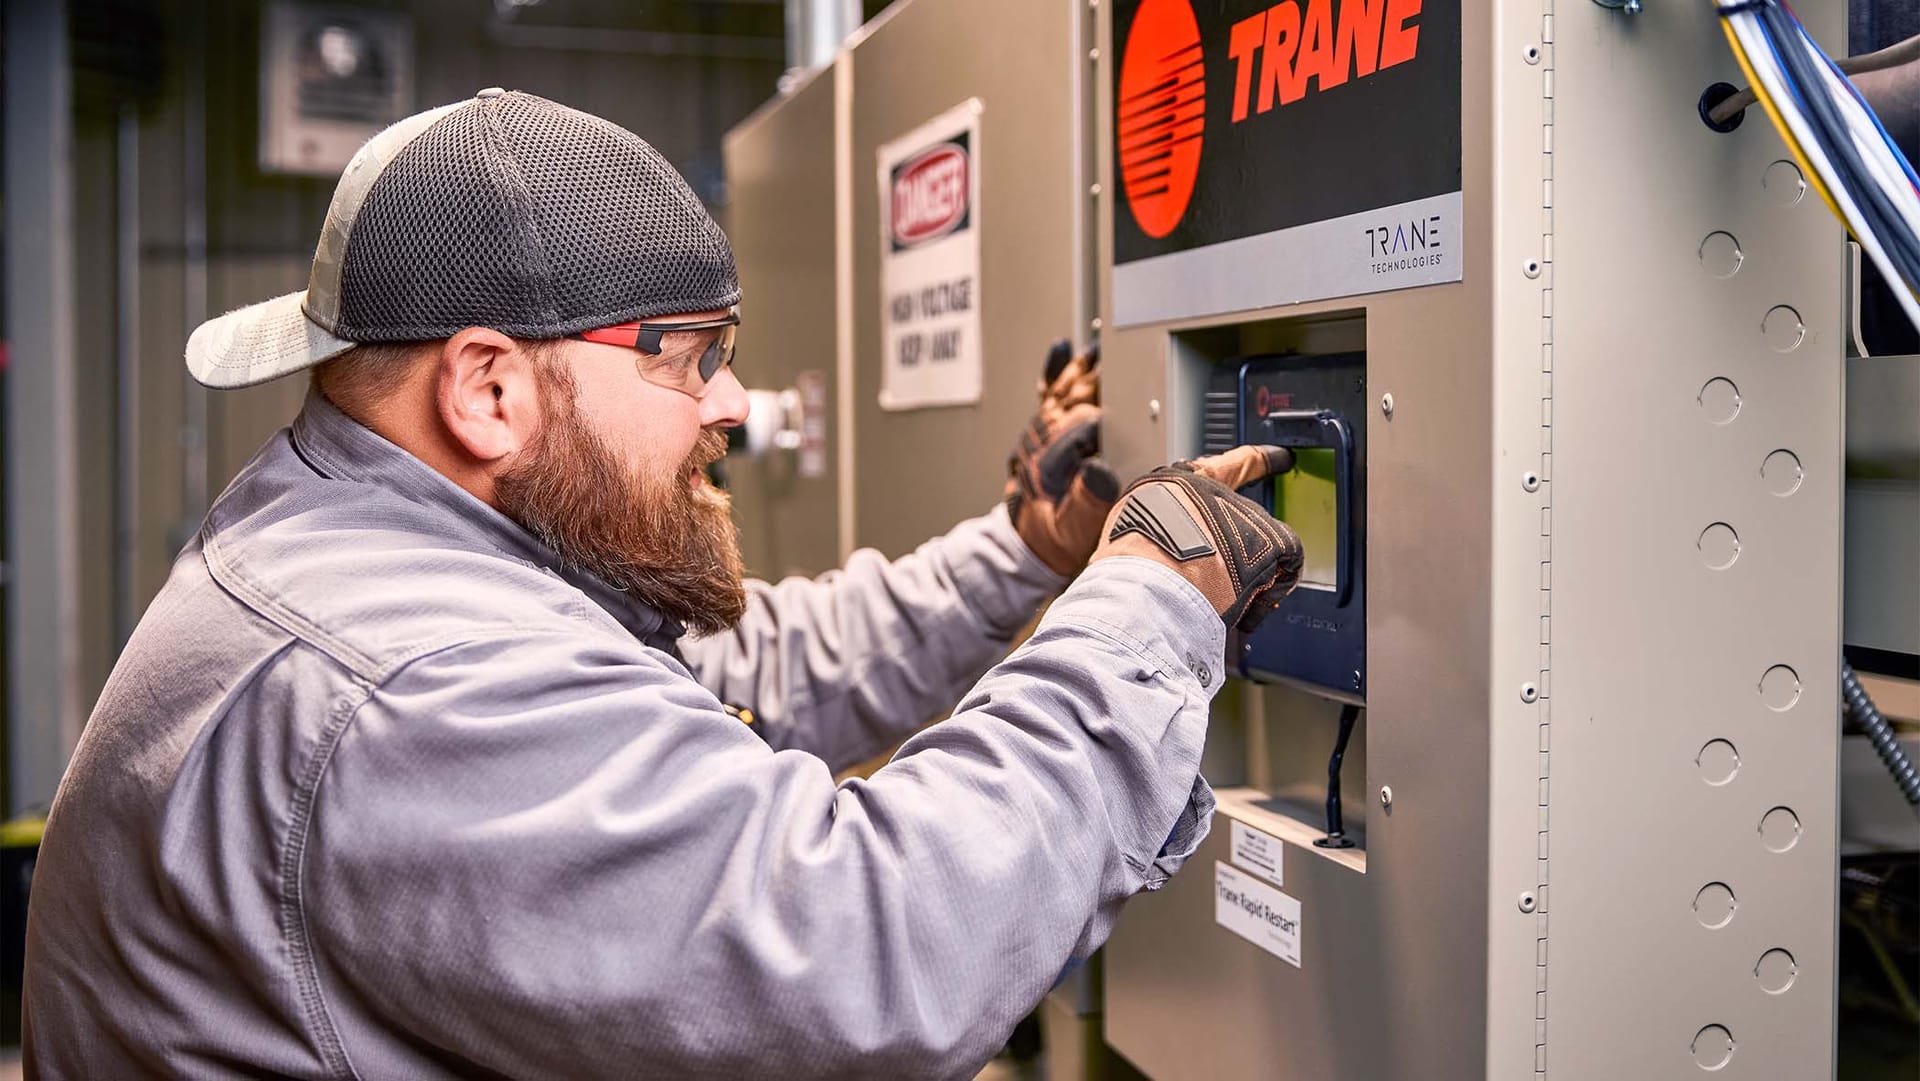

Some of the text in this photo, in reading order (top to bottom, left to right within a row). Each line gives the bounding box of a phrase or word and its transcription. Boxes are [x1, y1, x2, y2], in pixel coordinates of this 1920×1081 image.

[1228, 0, 1423, 123] TRANE
[1365, 216, 1441, 258] TRANE
[1240, 892, 1264, 919] Rapid
